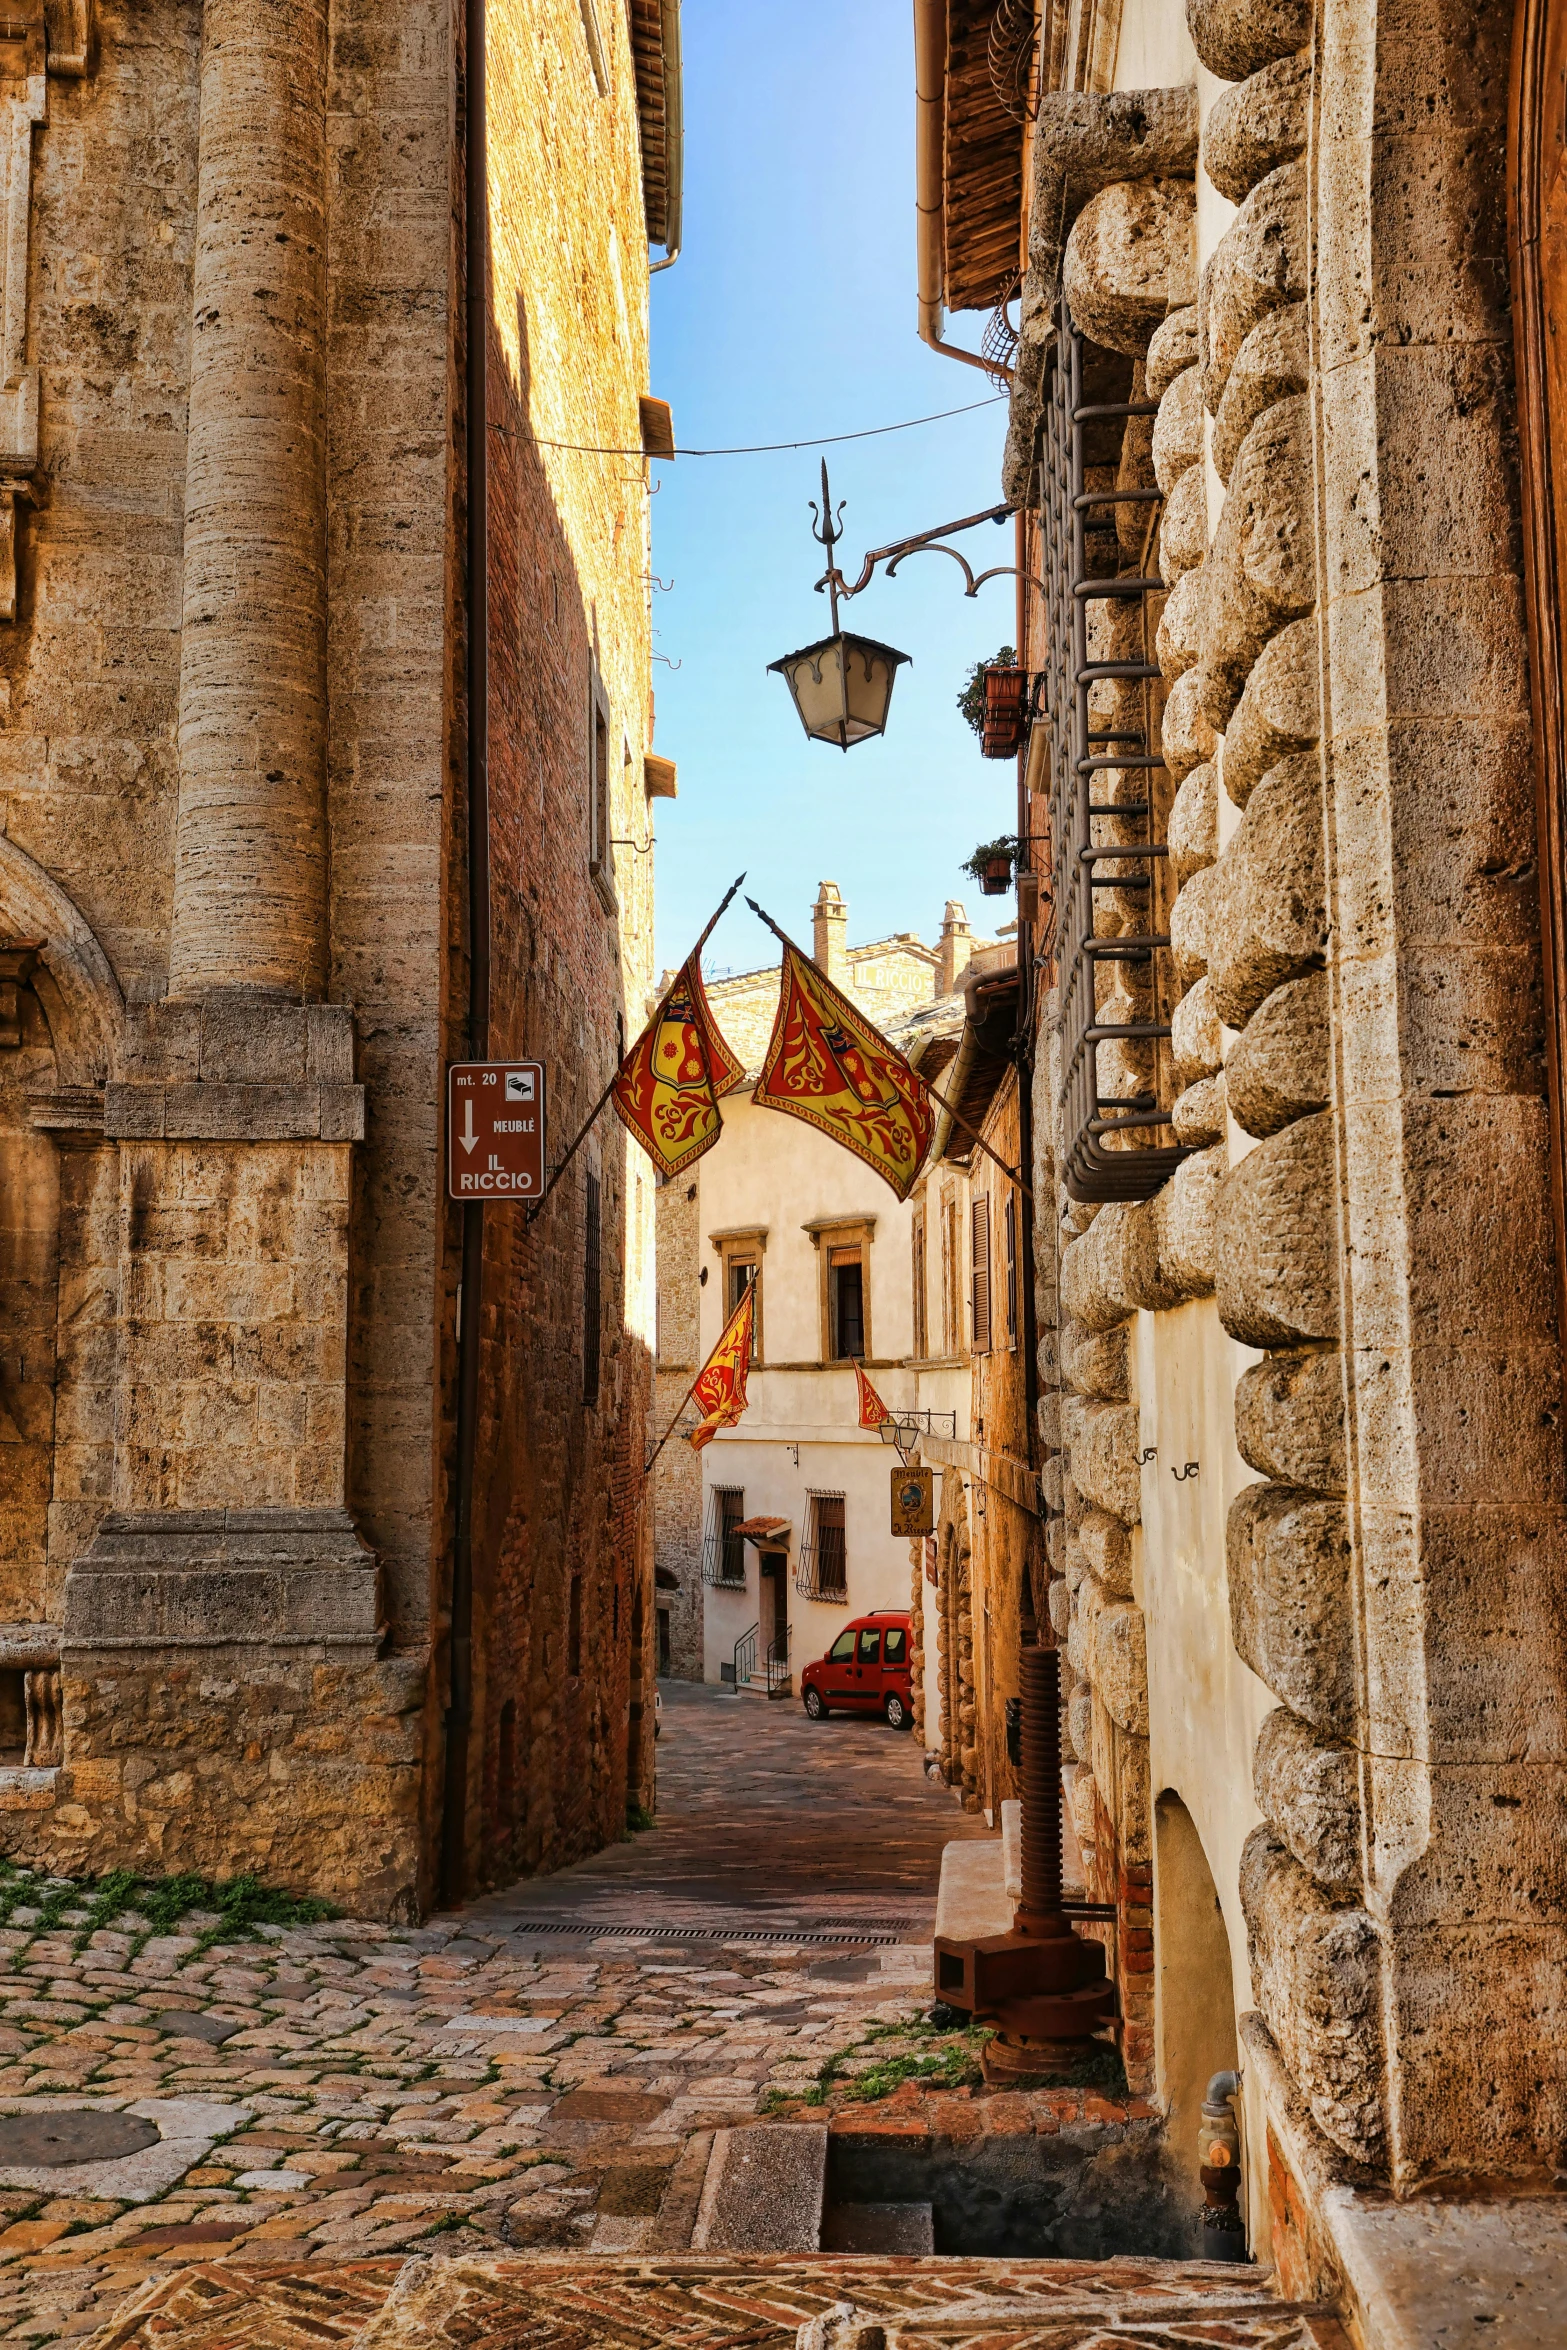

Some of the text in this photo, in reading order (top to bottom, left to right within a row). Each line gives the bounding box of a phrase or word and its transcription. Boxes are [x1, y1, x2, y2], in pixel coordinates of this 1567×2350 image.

[857, 966, 922, 991] IL RICCIO
[457, 1073, 497, 1086] mt. 20
[493, 1117, 535, 1133] MEUBLÈ
[488, 1154, 505, 1171] IL
[460, 1172, 533, 1190] RICCIO
